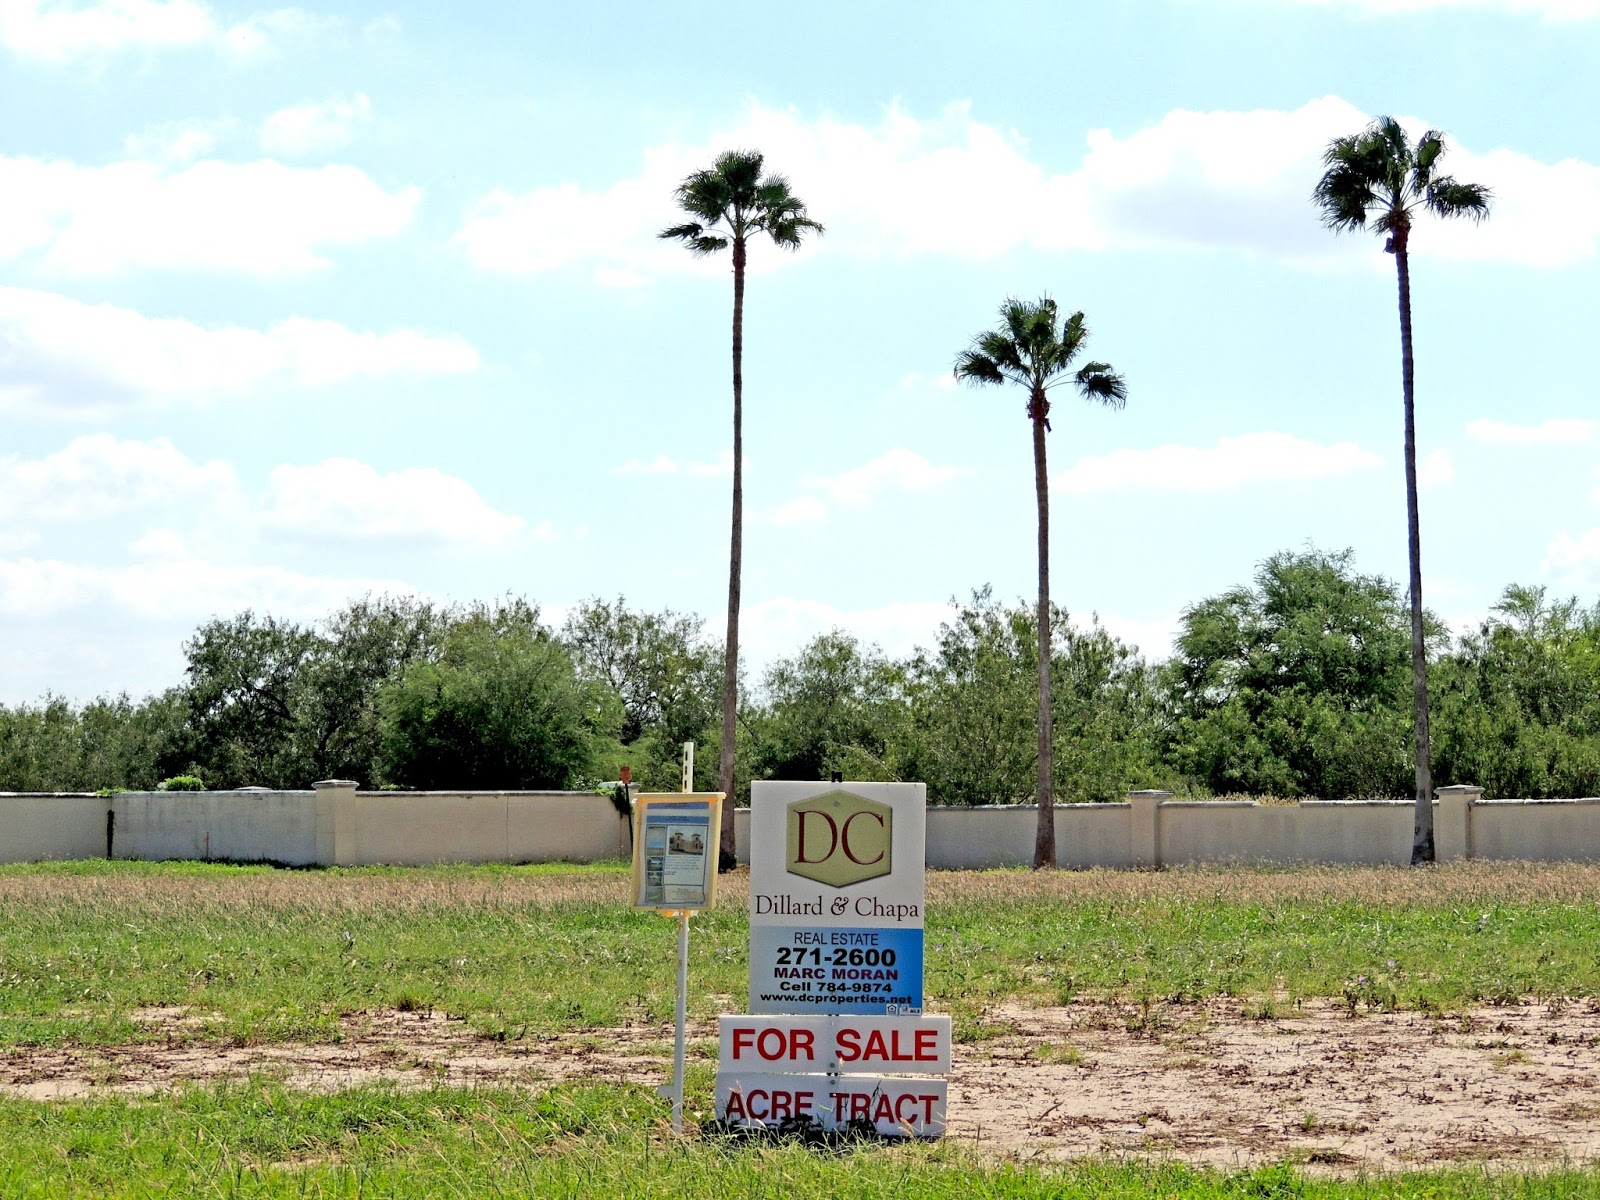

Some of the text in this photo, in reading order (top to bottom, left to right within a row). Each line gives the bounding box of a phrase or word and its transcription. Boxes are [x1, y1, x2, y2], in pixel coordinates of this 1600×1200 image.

[793, 809, 885, 866] DC
[755, 894, 919, 922] Dillard & Chapa
[794, 932, 879, 946] REAL ESTATE
[776, 947, 897, 967] 271-2600
[774, 967, 899, 981] MARC MORAN
[780, 981, 893, 993] Cell 784-9874
[760, 993, 913, 1005] www.dcproperties.net
[732, 1028, 938, 1062] FOR SALE
[726, 1089, 939, 1125] ACRE TRACT
